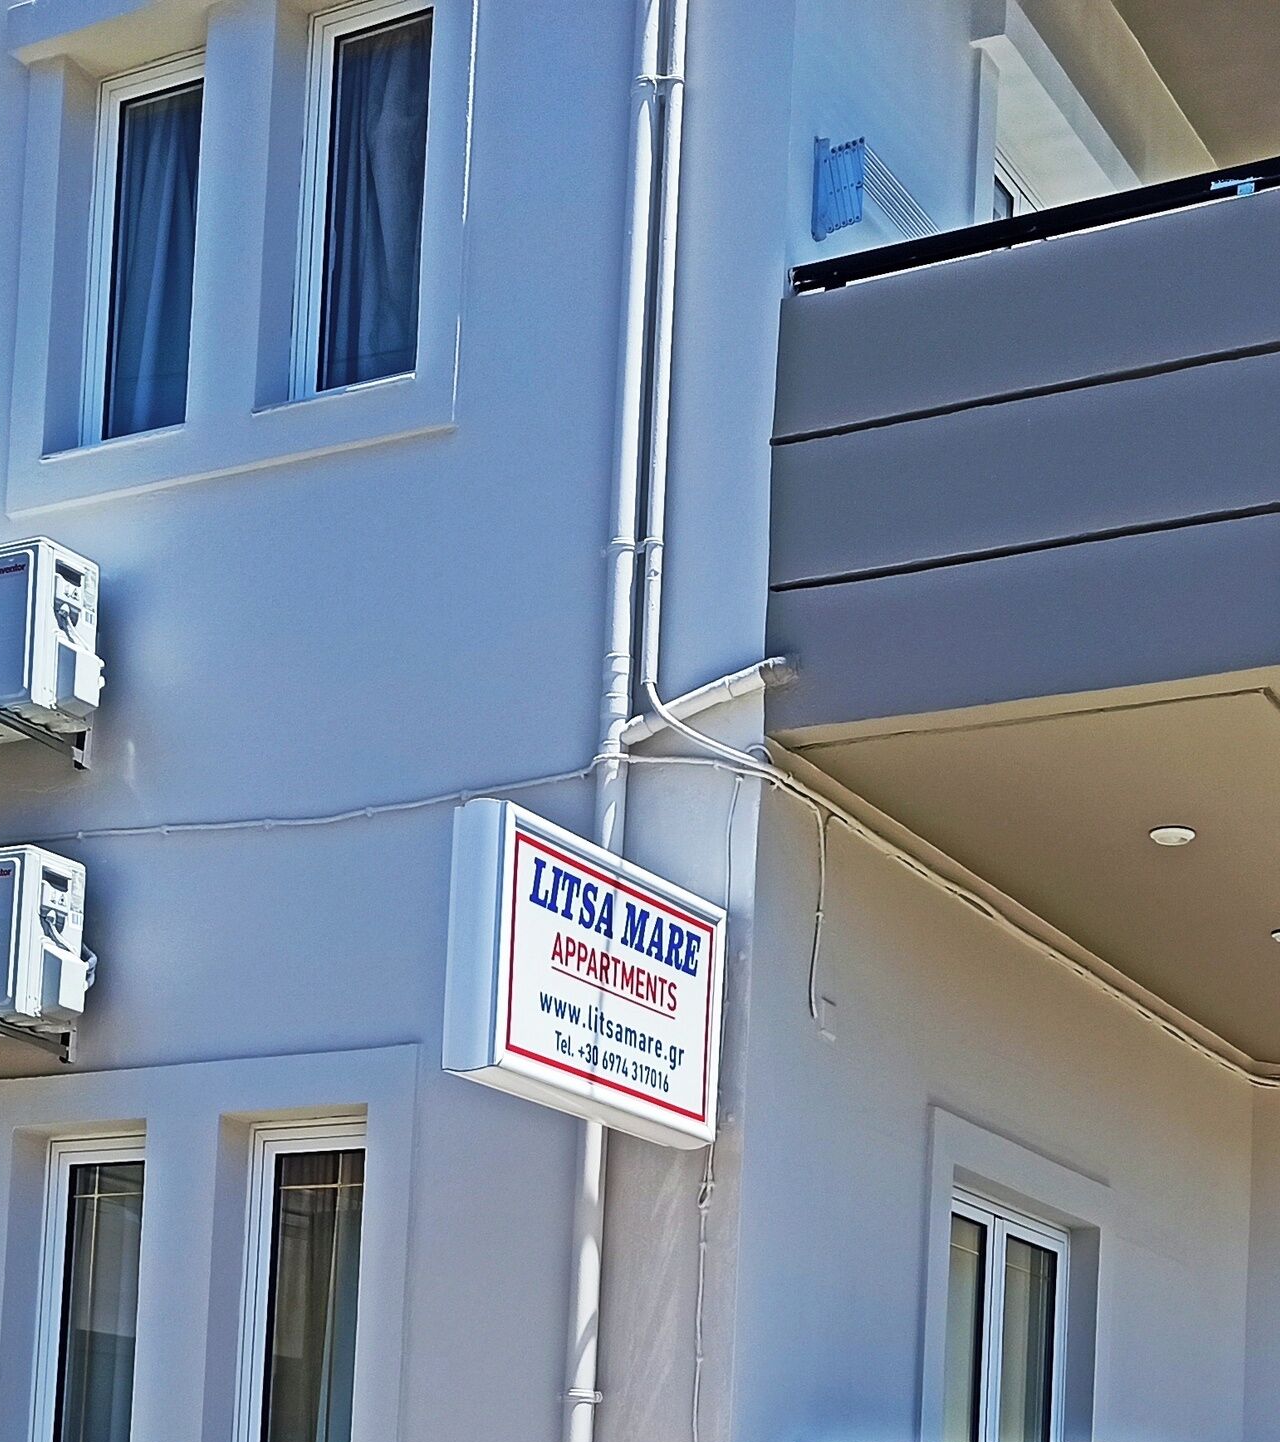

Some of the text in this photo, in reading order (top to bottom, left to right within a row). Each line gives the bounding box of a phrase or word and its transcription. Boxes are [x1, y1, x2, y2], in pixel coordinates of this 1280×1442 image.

[529, 856, 702, 977] LITSA MARE
[551, 931, 678, 1012] APPARTMENTS
[539, 991, 685, 1071] www.litsamare.gr
[555, 1030, 669, 1093] Tel. +30 6974 317016
